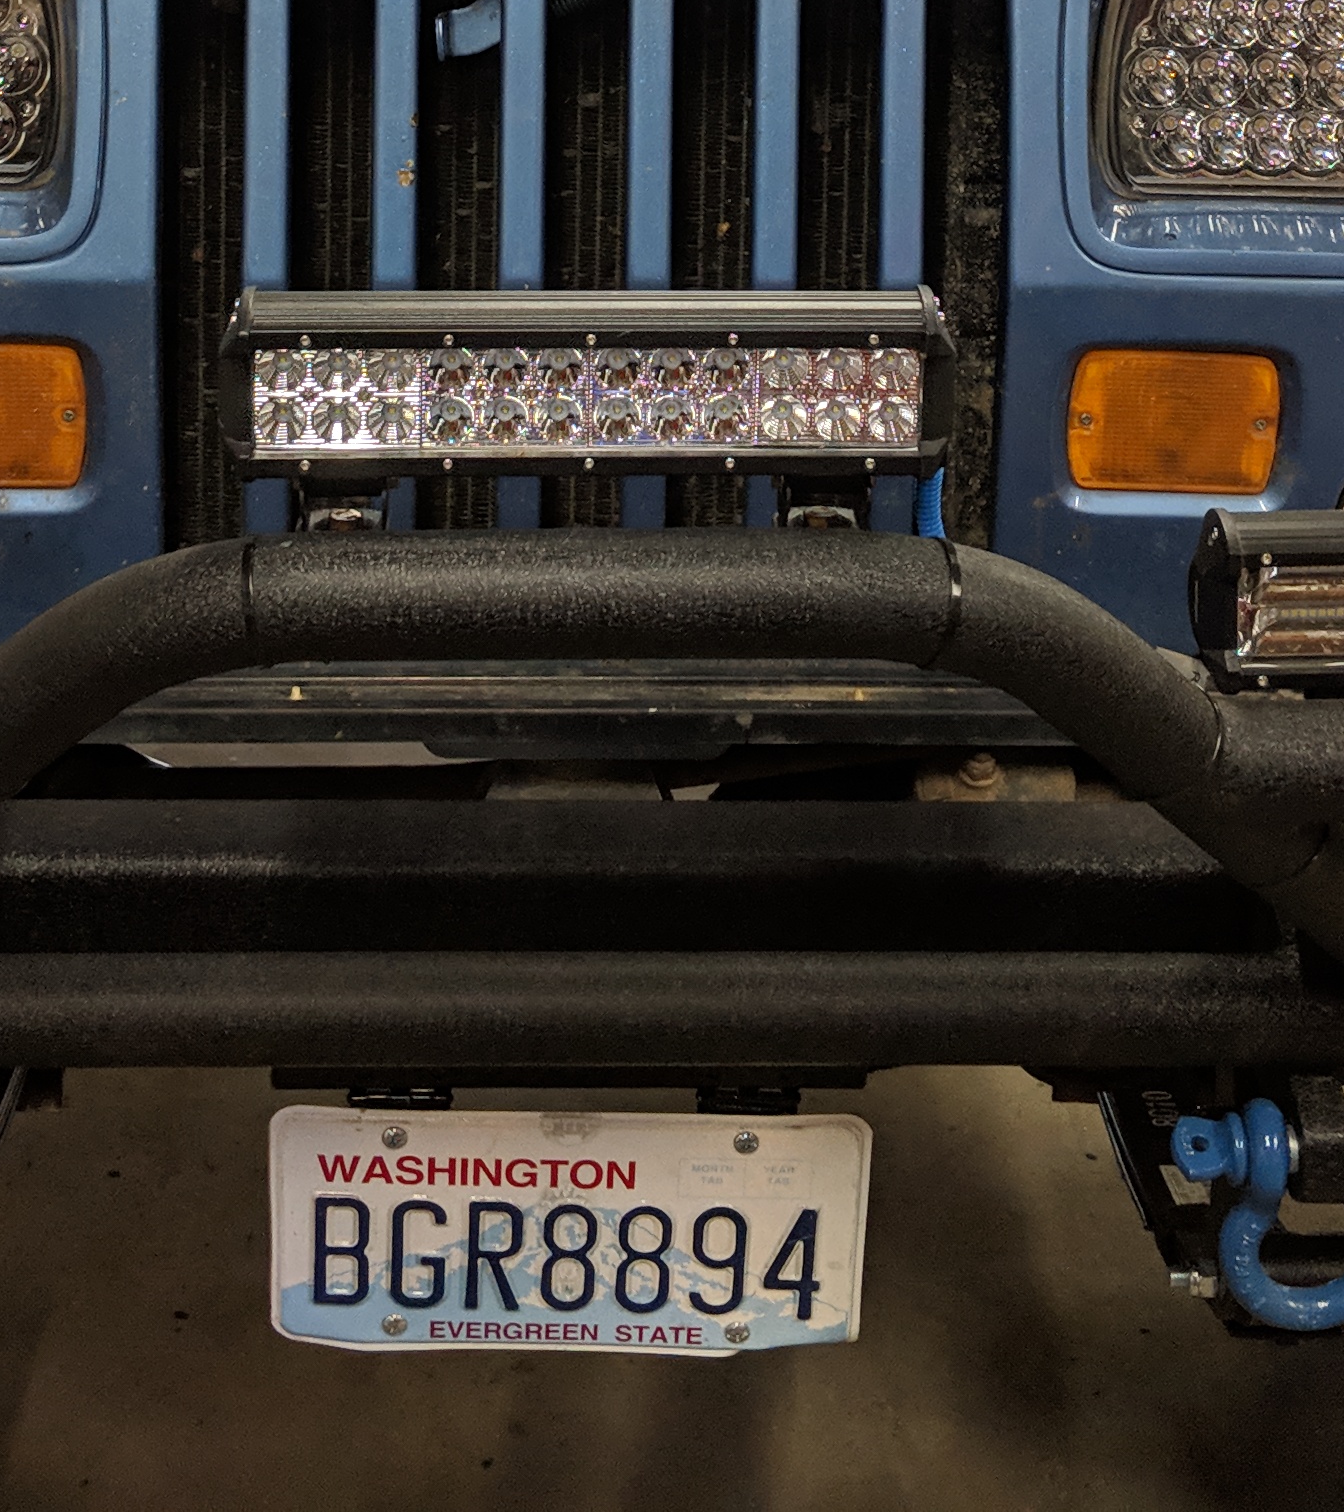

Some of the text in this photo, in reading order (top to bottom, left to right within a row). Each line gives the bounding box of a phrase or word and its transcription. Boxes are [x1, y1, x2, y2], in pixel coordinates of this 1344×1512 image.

[318, 1154, 637, 1190] WASHINGTON
[312, 1196, 821, 1321] BGR8894
[428, 1320, 703, 1345] EVERGREEN STATE
